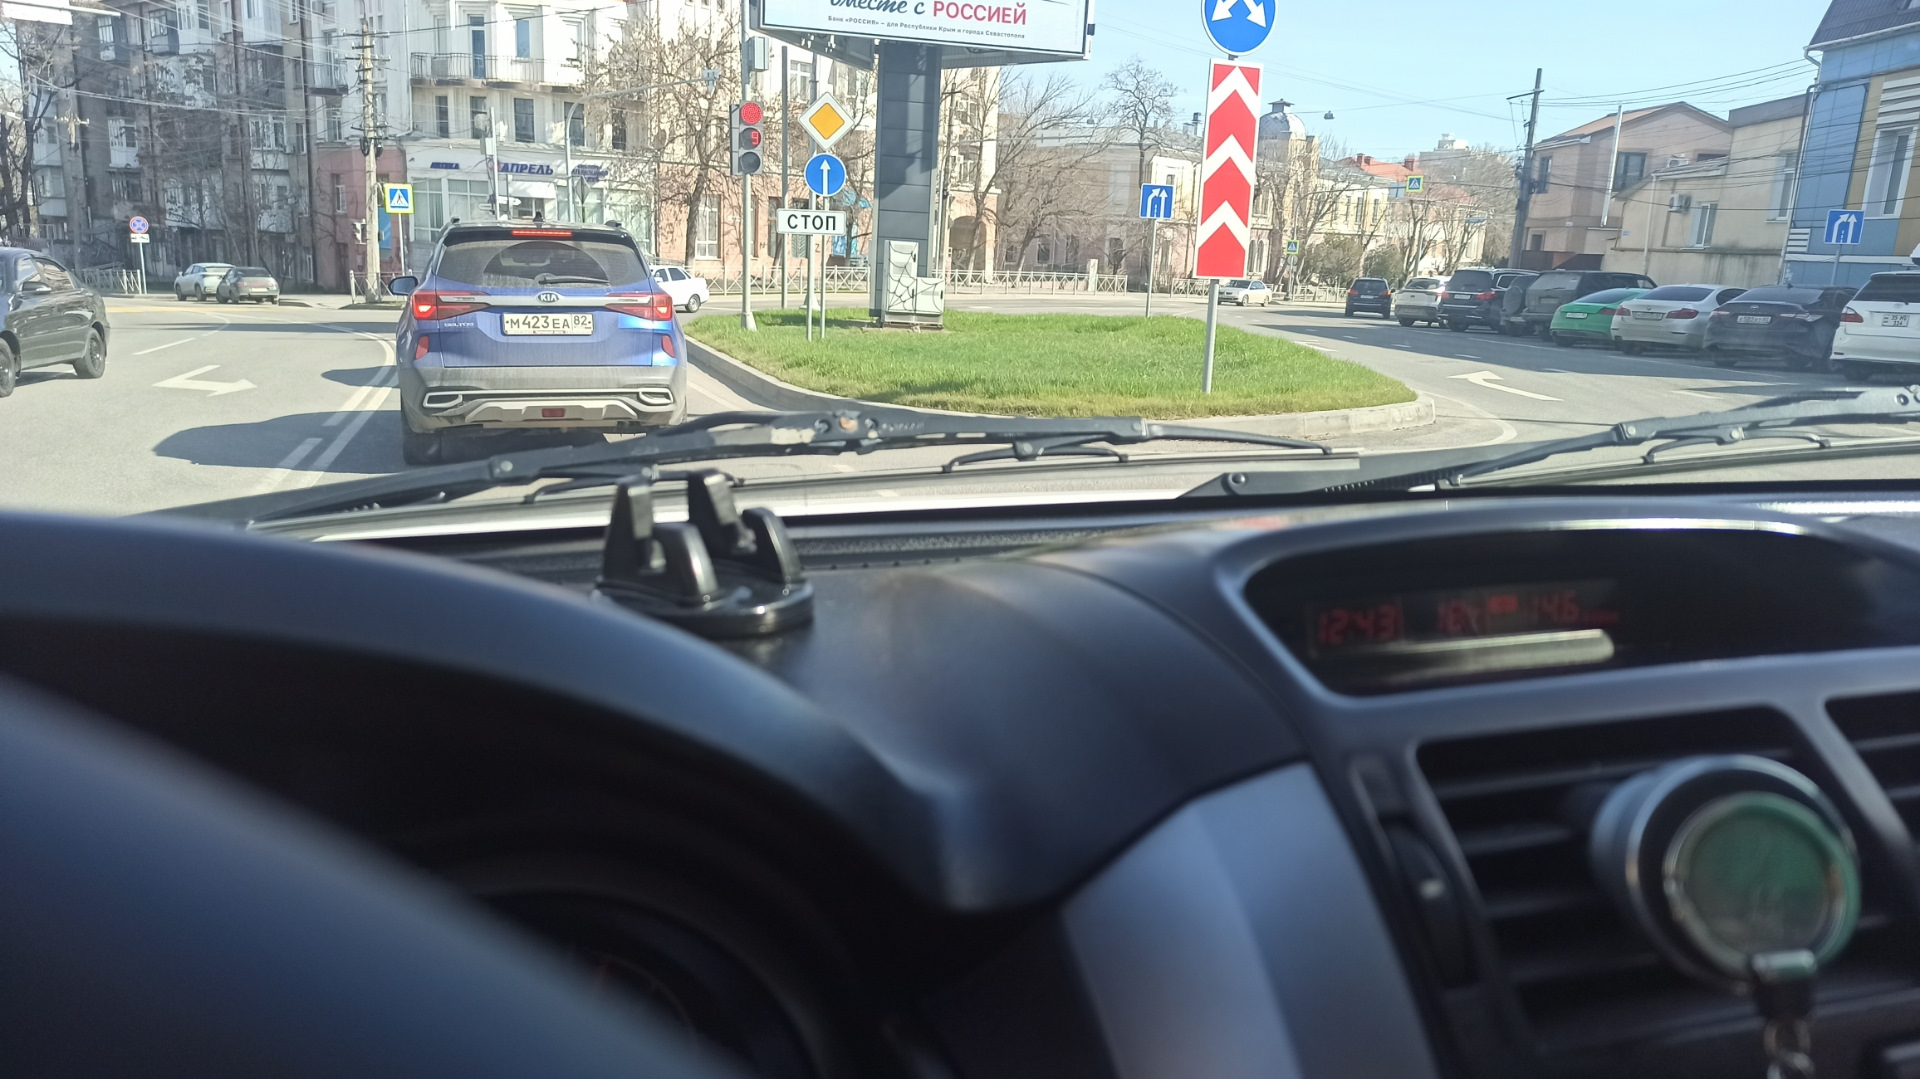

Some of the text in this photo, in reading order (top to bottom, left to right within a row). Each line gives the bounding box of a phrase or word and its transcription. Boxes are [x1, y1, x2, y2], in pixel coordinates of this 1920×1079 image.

[914, 1, 925, 15] с
[933, 0, 1027, 26] РОССИЕЙ
[845, 17, 879, 25] «РОССИЯ»
[900, 22, 937, 32] Республики
[985, 30, 1025, 39] Севастополя
[750, 130, 760, 147] 9
[501, 162, 554, 176] АПРЕЛЬ
[787, 213, 836, 231] СТОП
[539, 293, 559, 303] KIA
[510, 315, 588, 329] М423ЕА 82
